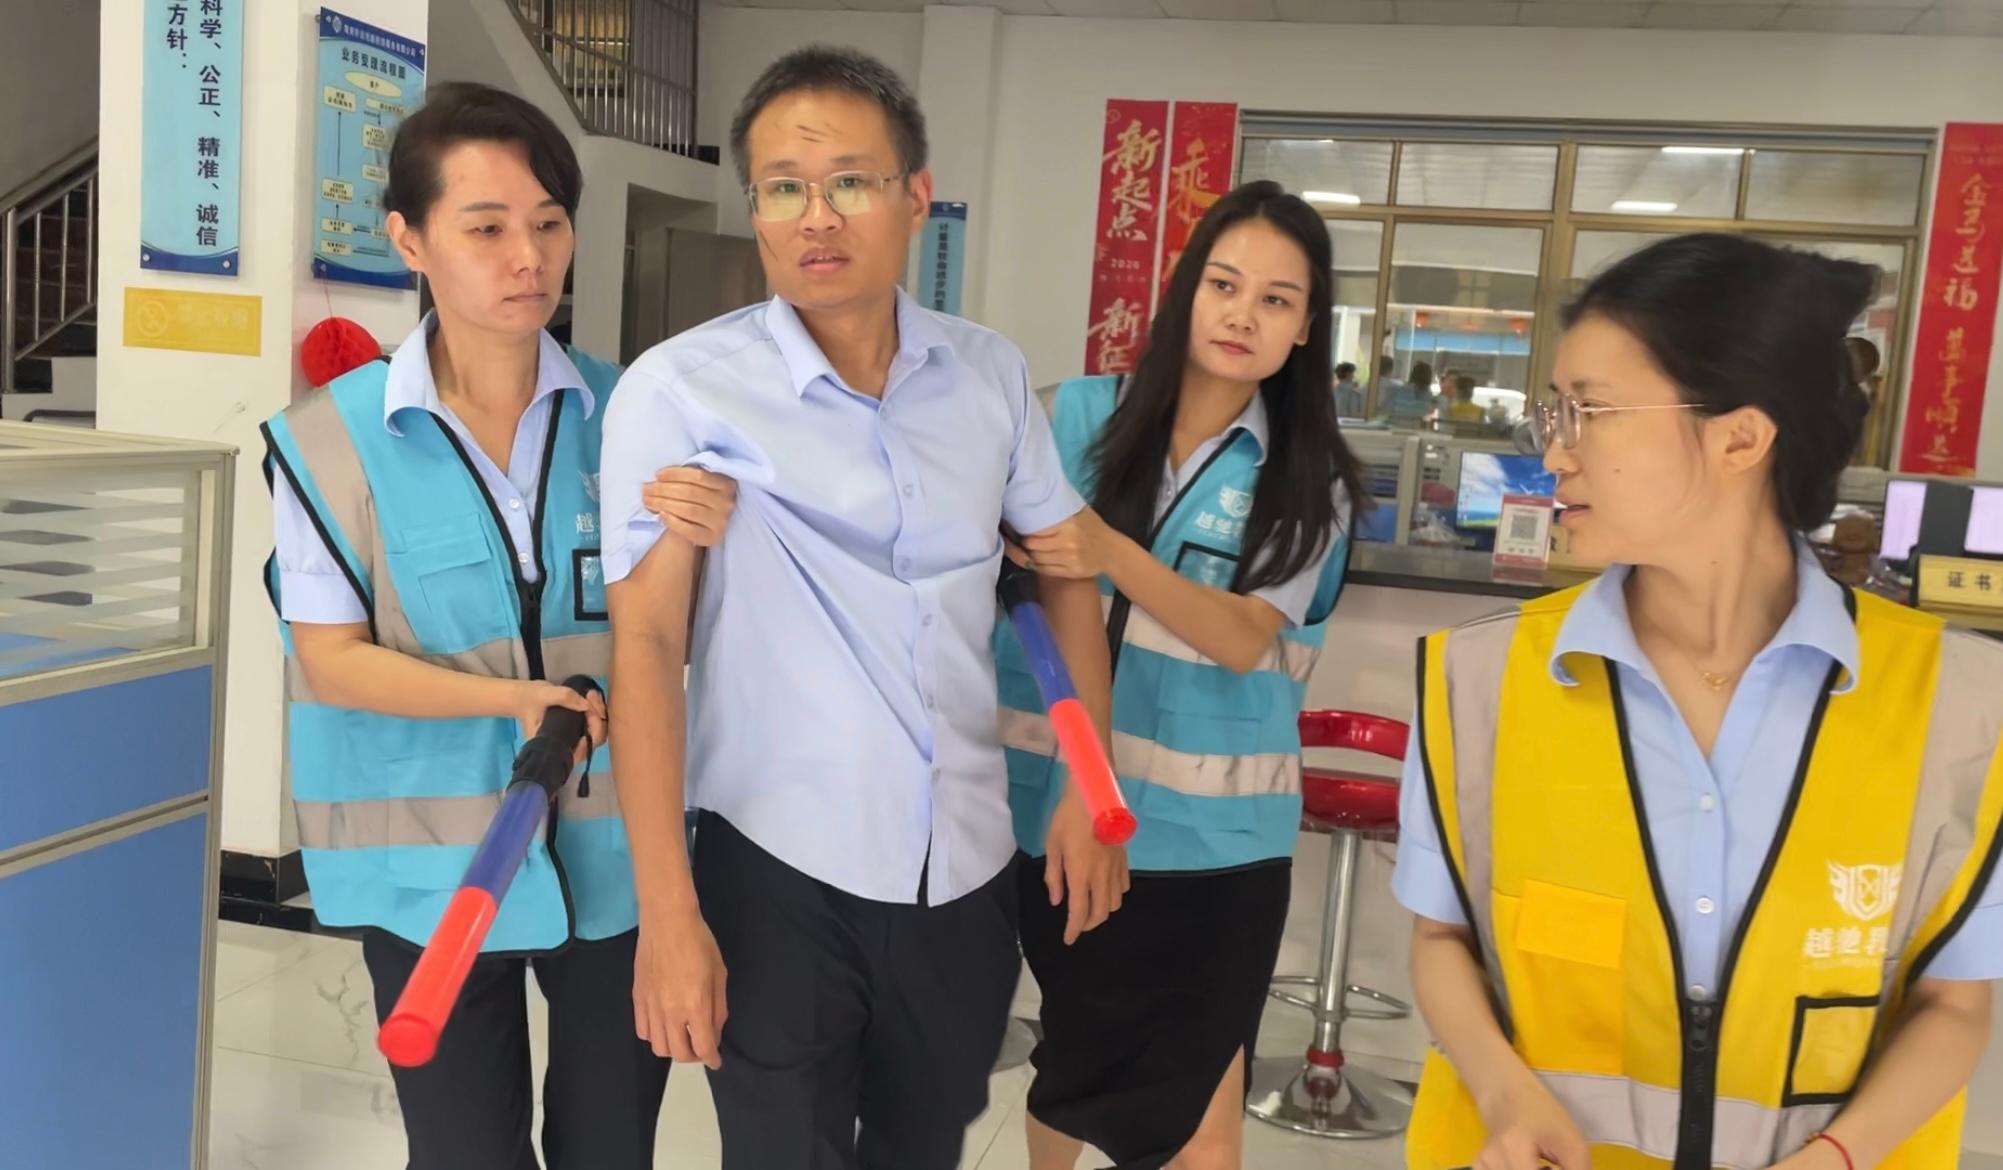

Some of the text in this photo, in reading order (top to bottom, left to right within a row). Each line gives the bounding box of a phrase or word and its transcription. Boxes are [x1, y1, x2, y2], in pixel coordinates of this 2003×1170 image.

[166, 0, 188, 69] 方针：
[1101, 119, 1162, 241] 新起点
[1165, 137, 1222, 252] 乘
[576, 512, 600, 535] 越
[1947, 570, 2003, 592] 证书
